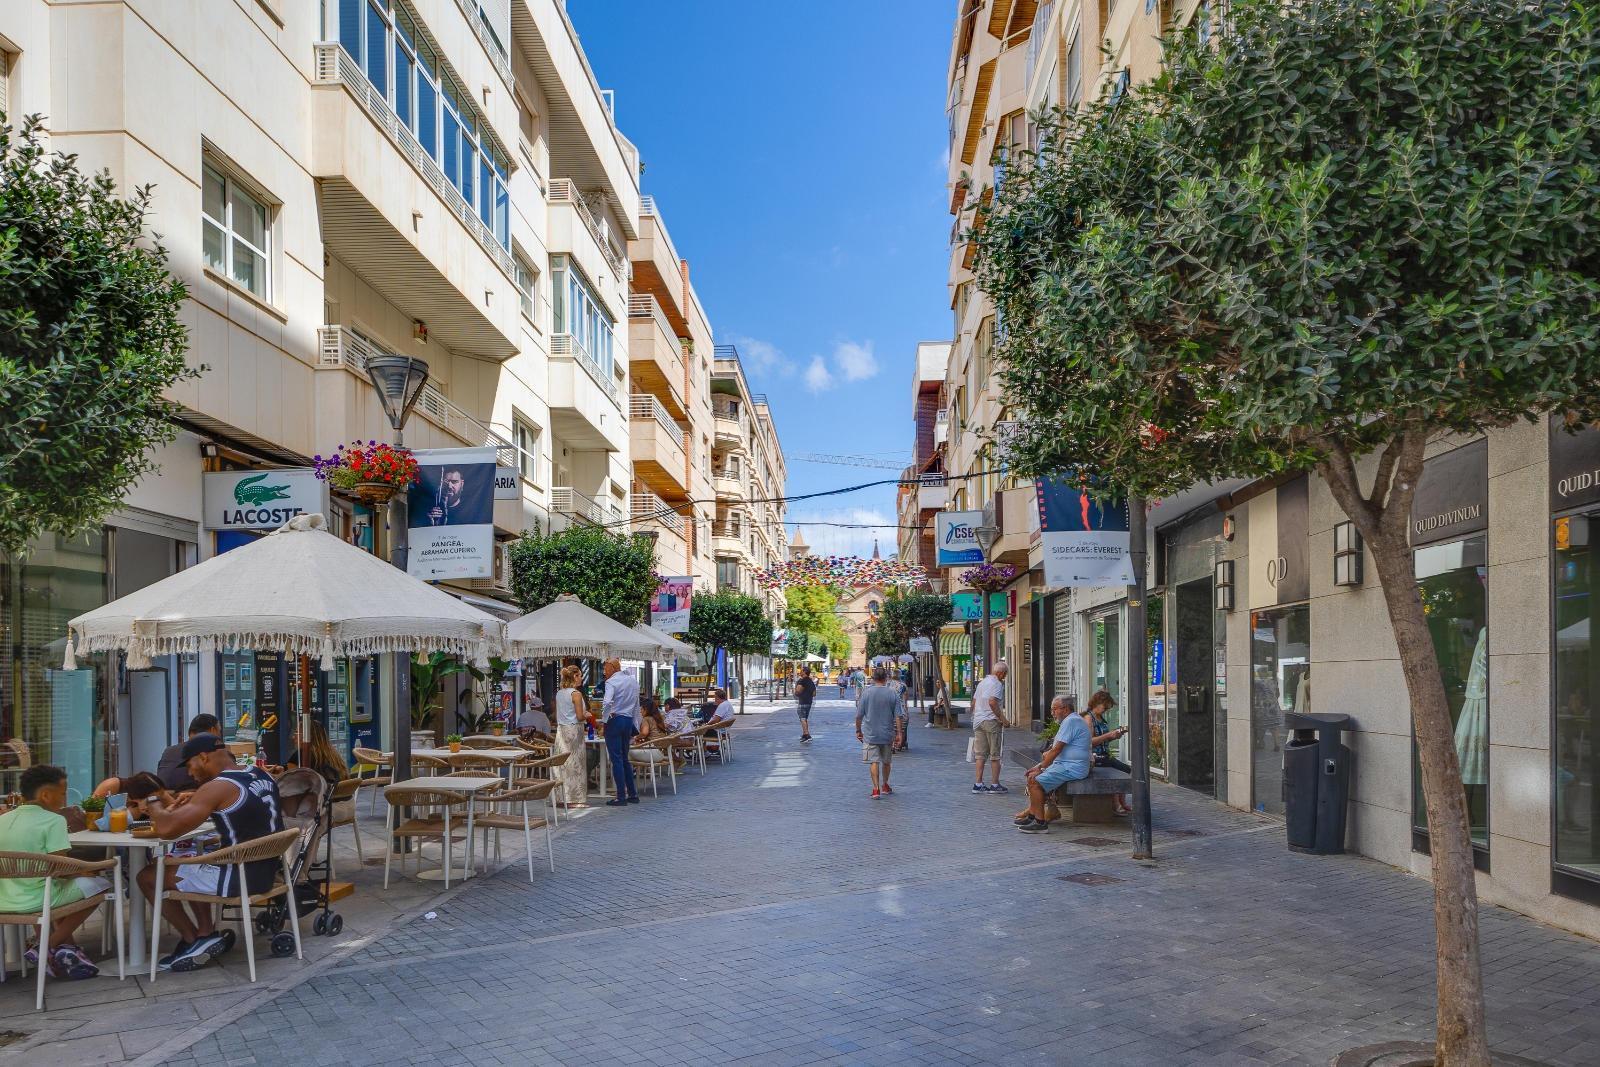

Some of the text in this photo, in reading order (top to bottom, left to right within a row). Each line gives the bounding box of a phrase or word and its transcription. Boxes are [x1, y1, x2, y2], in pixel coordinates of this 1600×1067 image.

[1558, 473, 1592, 497] QUID
[1415, 504, 1481, 535] QUID DIVINUM
[421, 548, 448, 556] ABRAHAM
[431, 540, 464, 548] PANGEA:
[261, 794, 277, 832] 7
